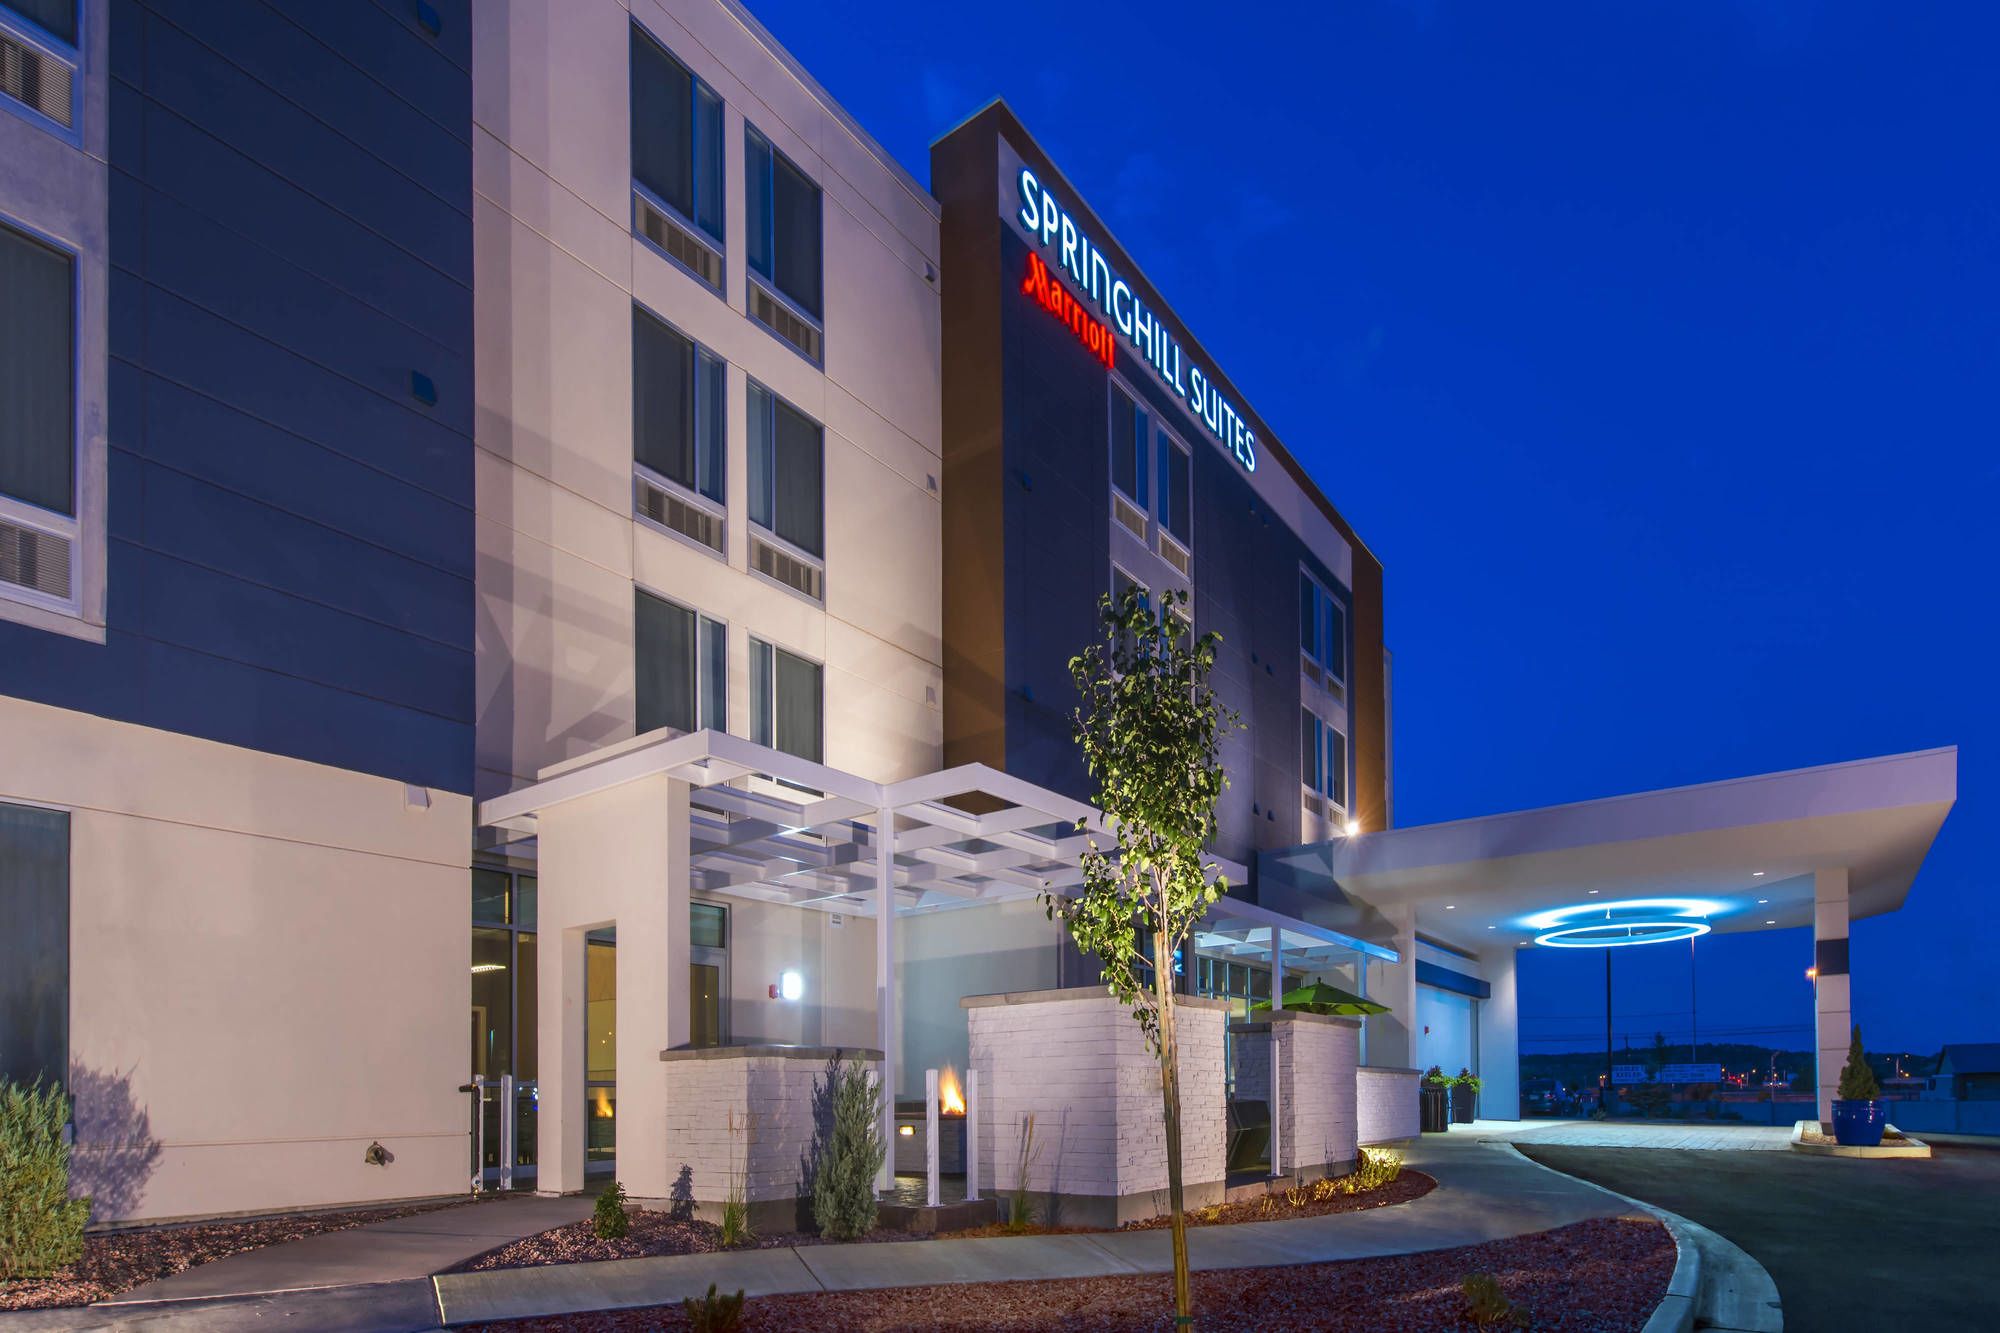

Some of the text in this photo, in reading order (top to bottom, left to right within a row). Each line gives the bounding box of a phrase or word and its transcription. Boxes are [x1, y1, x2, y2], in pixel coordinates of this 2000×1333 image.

[1019, 169, 1256, 473] SPRINGHILL SUITES
[1021, 250, 1116, 370] Marriott
